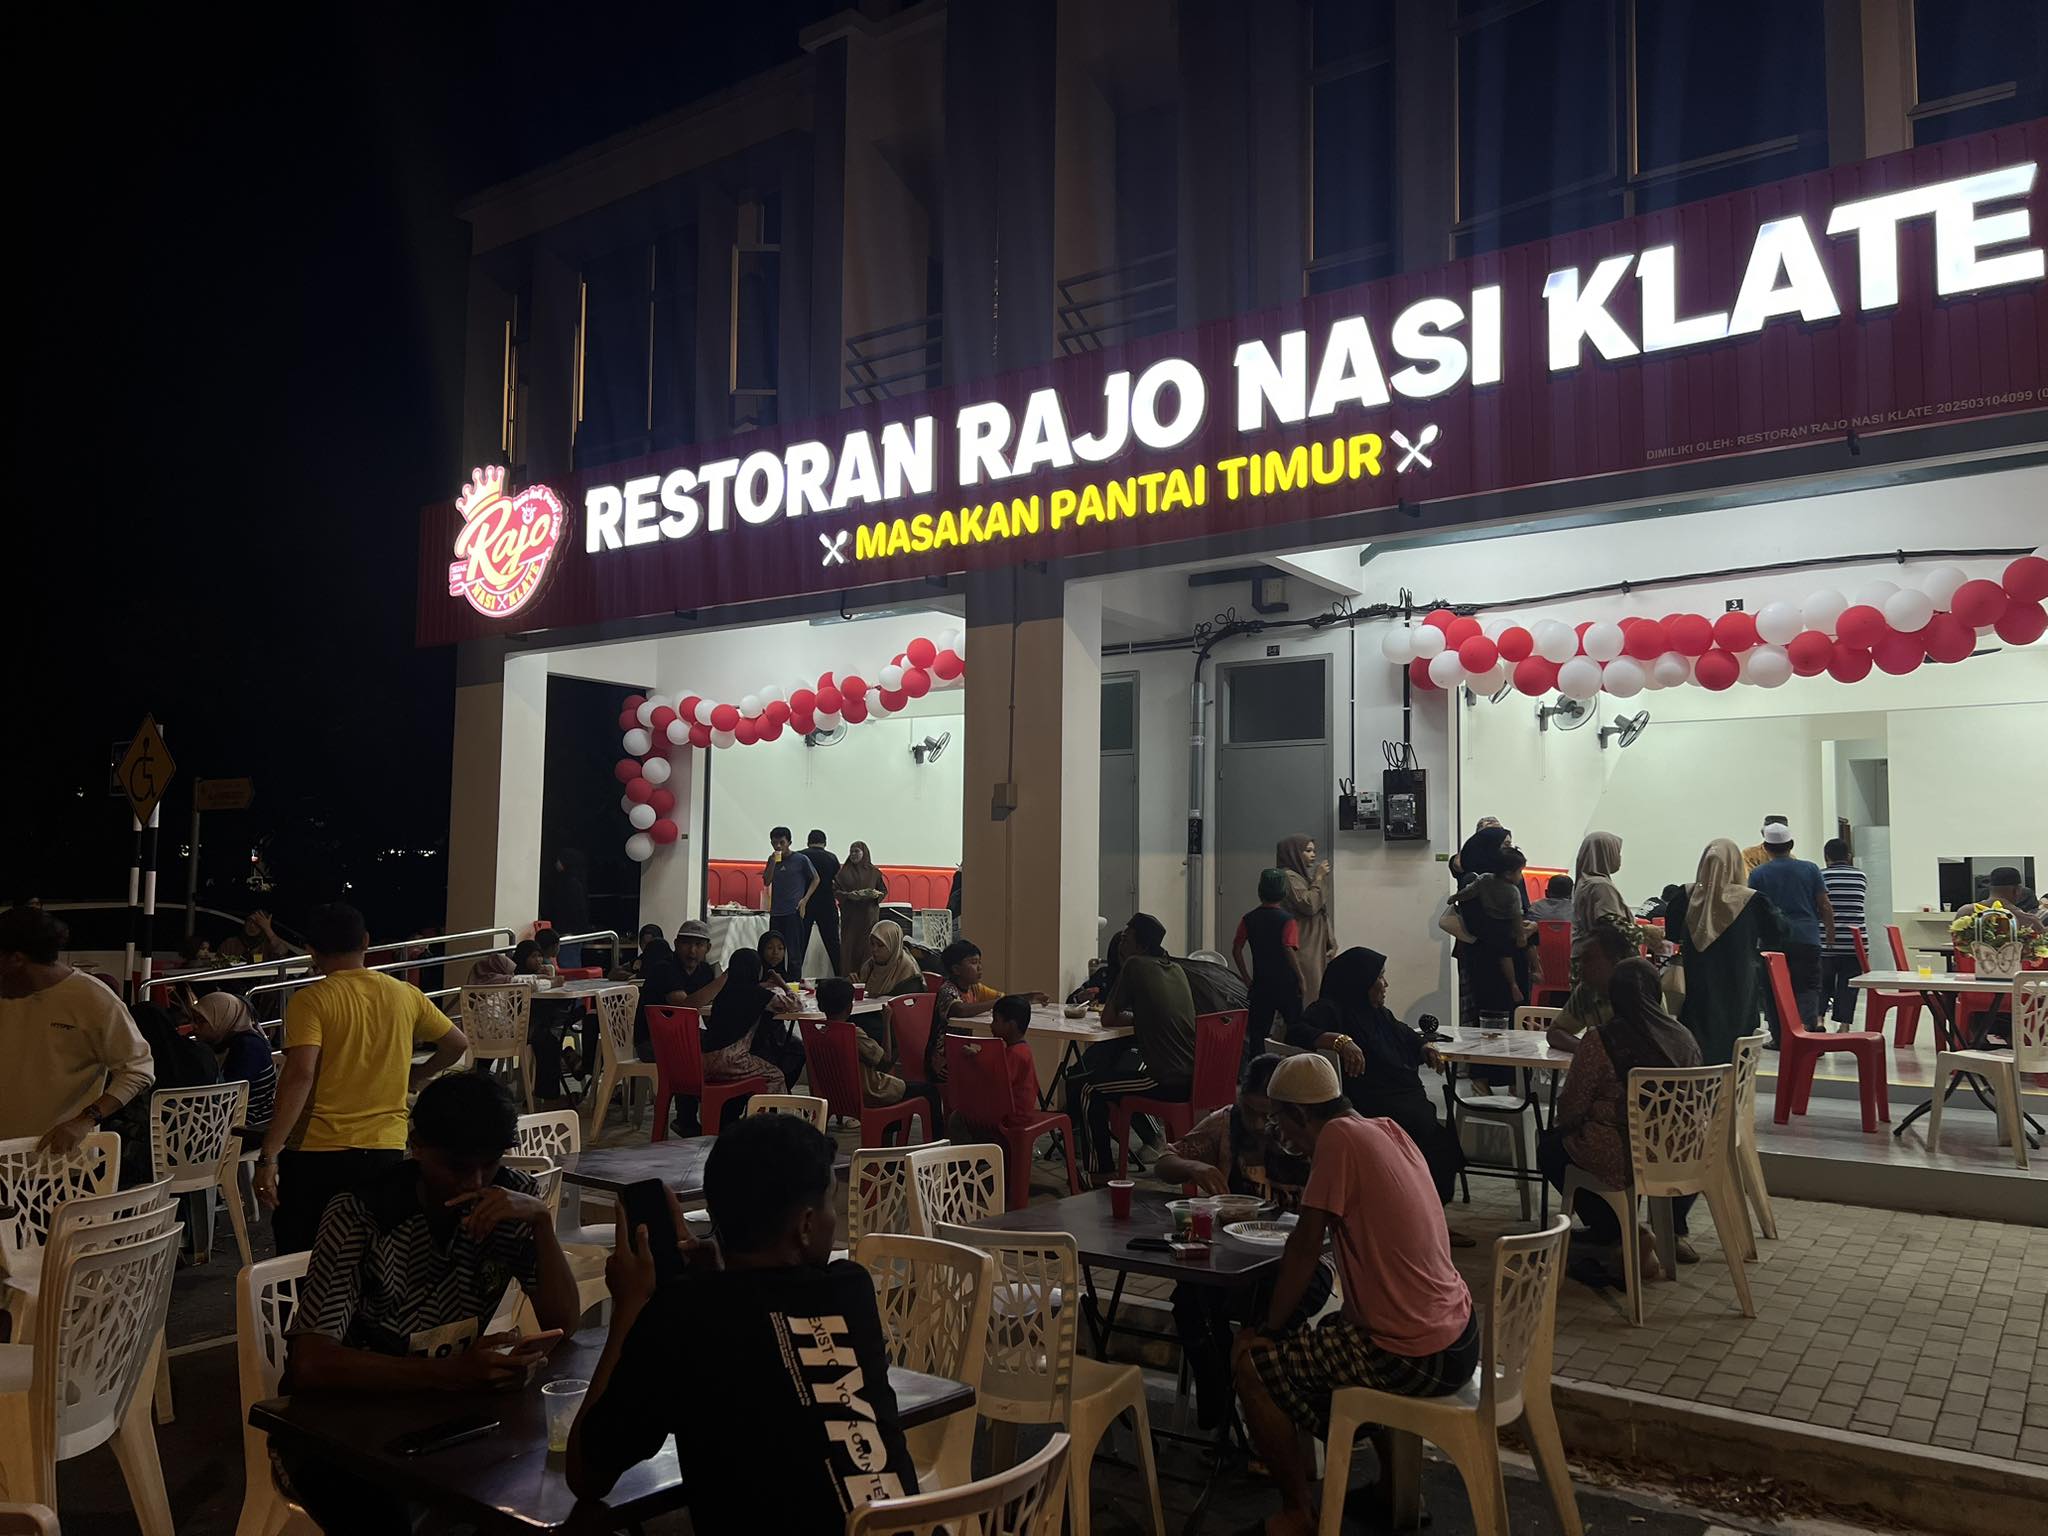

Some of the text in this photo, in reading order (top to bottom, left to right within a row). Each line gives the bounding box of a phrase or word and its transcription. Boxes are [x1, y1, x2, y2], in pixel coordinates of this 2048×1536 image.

[585, 162, 2046, 555] RESTORAN RAJO NASI KLATE
[1646, 444, 1693, 460] DIMILIKI
[1696, 438, 1734, 452] OLEH:
[1737, 426, 1808, 445] RESTORAN
[1810, 419, 1848, 433] RAJO
[1851, 413, 1884, 427] NASI
[1887, 405, 1933, 421] KLATE
[1936, 390, 2033, 414] 202503104099
[855, 433, 1383, 561] MASAKAN PANTAI TIMUR
[454, 499, 551, 588] Rajo
[471, 582, 497, 609] NASI
[508, 561, 541, 606] KLATE
[807, 1315, 835, 1354] EXIST
